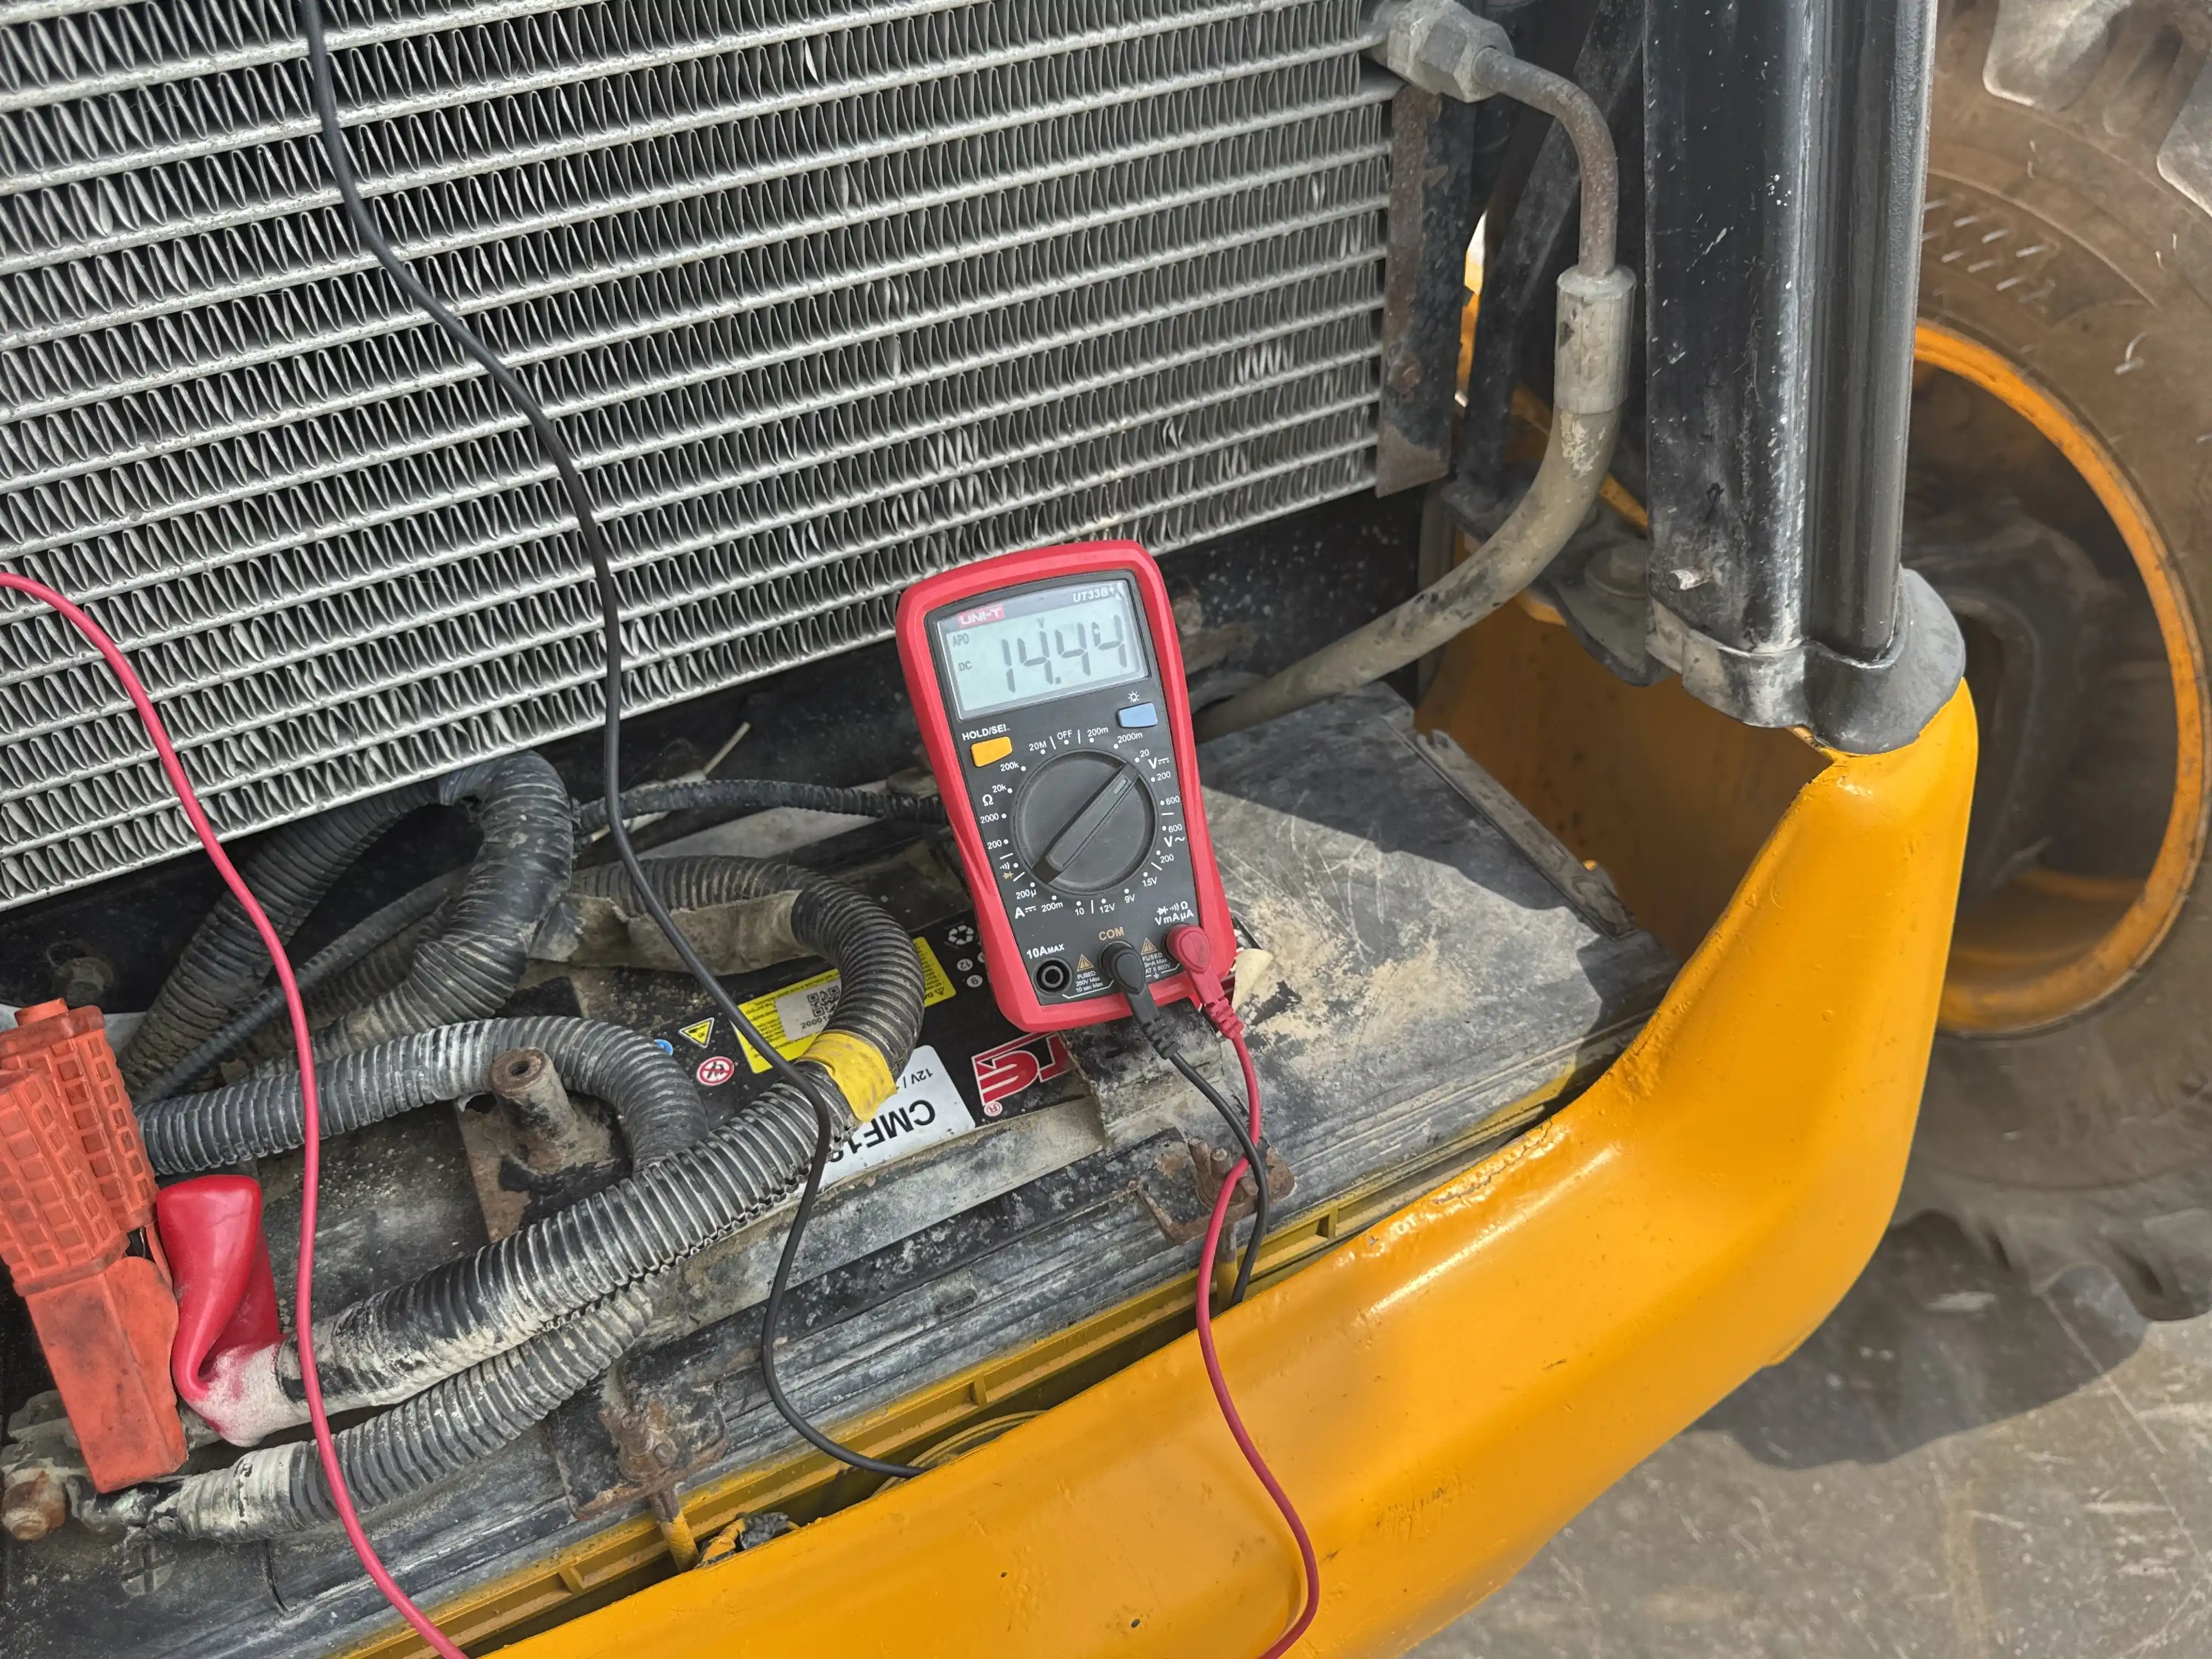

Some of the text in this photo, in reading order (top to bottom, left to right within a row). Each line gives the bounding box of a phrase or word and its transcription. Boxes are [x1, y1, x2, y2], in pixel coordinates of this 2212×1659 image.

[960, 608, 1002, 625] UNI-T
[952, 633, 969, 646] APO
[1002, 614, 1127, 692] 14.44
[958, 661, 972, 672] DC
[962, 724, 1010, 741] HOLD/SEL
[1057, 730, 1073, 740] OFF
[1087, 727, 1108, 737] 200m
[1118, 732, 1143, 744] 2000m
[1029, 741, 1047, 751] 20M
[1139, 749, 1149, 758] 20
[1000, 761, 1019, 771] 200k
[1157, 771, 1171, 781] 200
[992, 784, 1007, 793] 20k
[1166, 796, 1180, 805] 600
[980, 813, 999, 823] 2000
[1168, 823, 1182, 832] 600
[988, 840, 1002, 849] 200
[1160, 854, 1174, 863] 200
[1142, 877, 1157, 887] 1.5V
[1124, 894, 1135, 904] 9V
[1041, 902, 1063, 912] 200m
[1075, 907, 1085, 916] 10
[1099, 903, 1115, 914] 12V
[1099, 927, 1125, 941] COM
[1142, 952, 1163, 962] FUSED
[1077, 970, 1096, 980] FUSED
[911, 1068, 933, 1084] 12V
